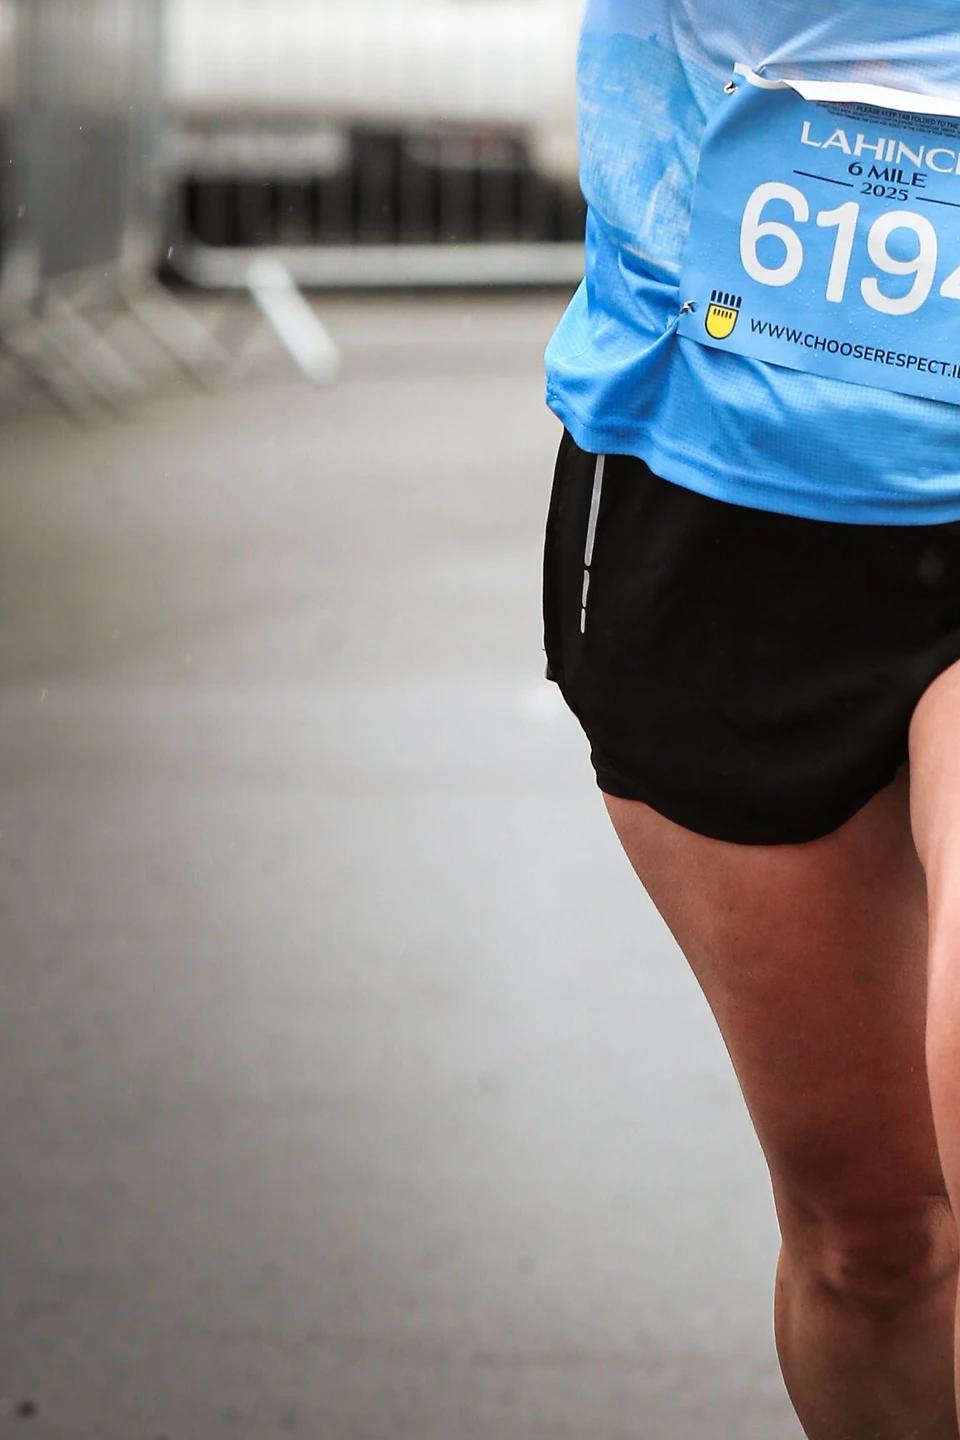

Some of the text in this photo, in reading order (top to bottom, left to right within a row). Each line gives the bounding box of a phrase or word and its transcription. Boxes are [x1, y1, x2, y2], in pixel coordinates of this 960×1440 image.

[848, 161, 928, 189] 6 MILE
[860, 182, 909, 202] 2025
